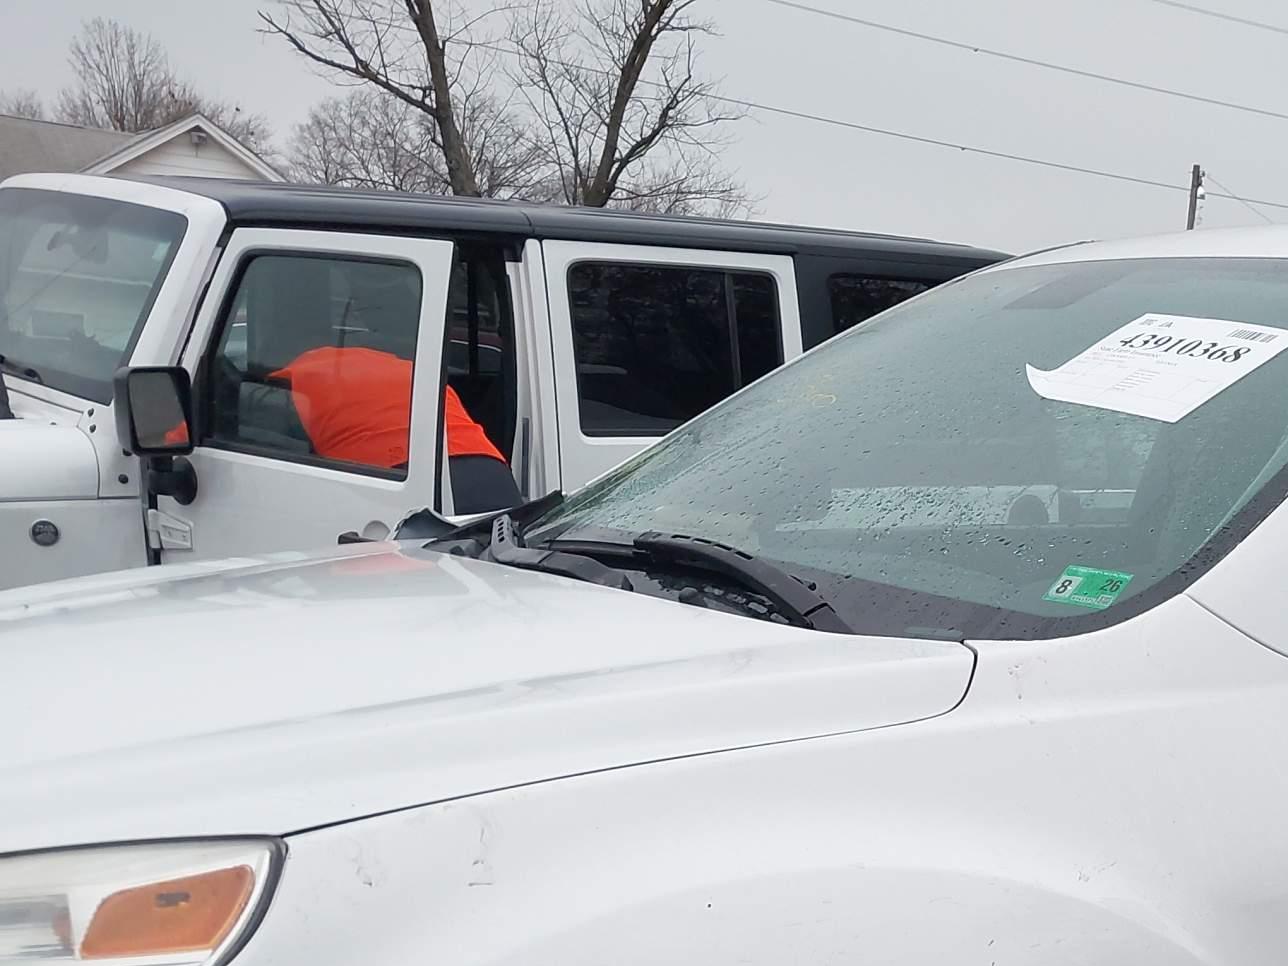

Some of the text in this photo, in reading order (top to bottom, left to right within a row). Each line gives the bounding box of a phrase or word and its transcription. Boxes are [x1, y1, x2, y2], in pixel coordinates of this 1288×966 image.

[1119, 332, 1251, 363] 43910368
[1055, 578, 1123, 594] 8 26
